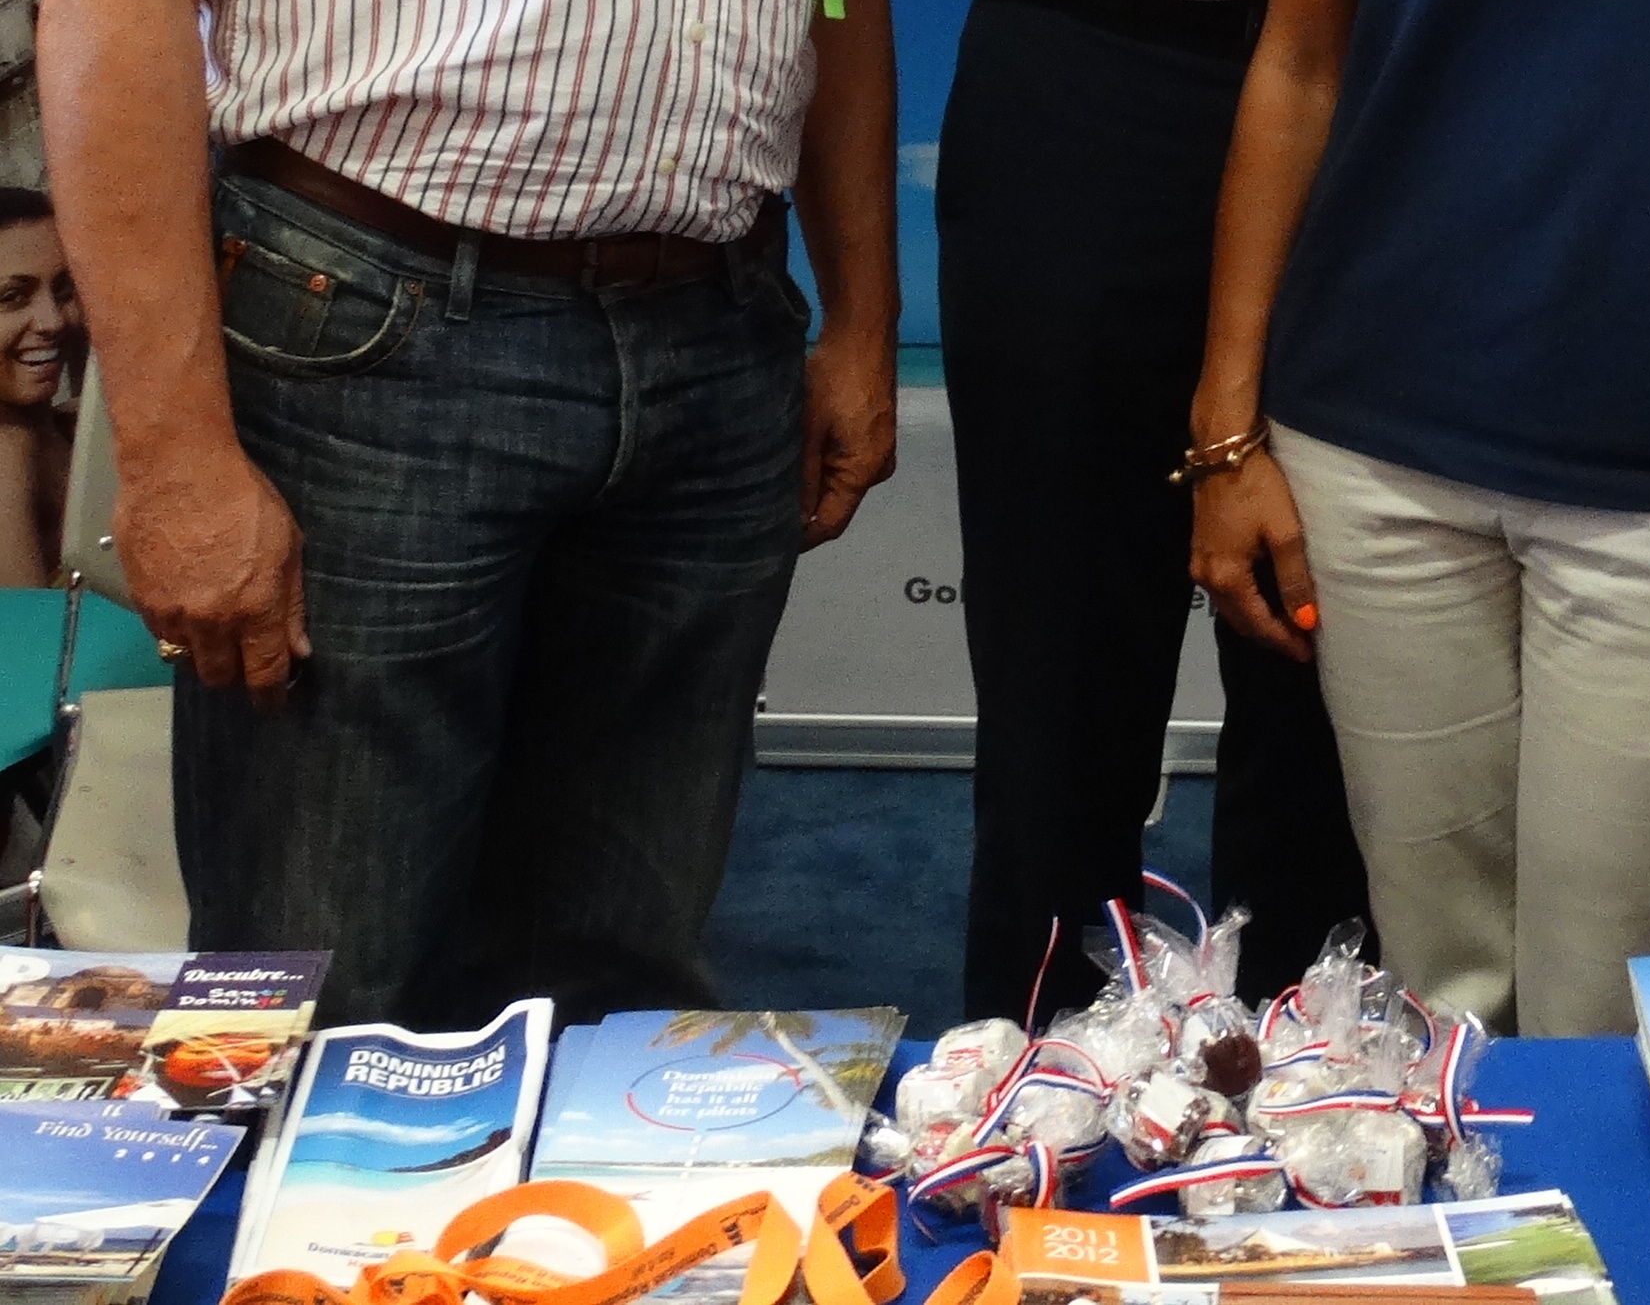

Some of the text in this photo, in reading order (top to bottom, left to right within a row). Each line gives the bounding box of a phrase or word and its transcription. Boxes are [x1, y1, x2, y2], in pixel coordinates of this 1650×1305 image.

[350, 1044, 506, 1080] DOMINICAN
[345, 1062, 504, 1096] REPUBLIC
[34, 1120, 94, 1138] Find
[1042, 1224, 1118, 1246] 2011
[1045, 1242, 1120, 1265] 2012
